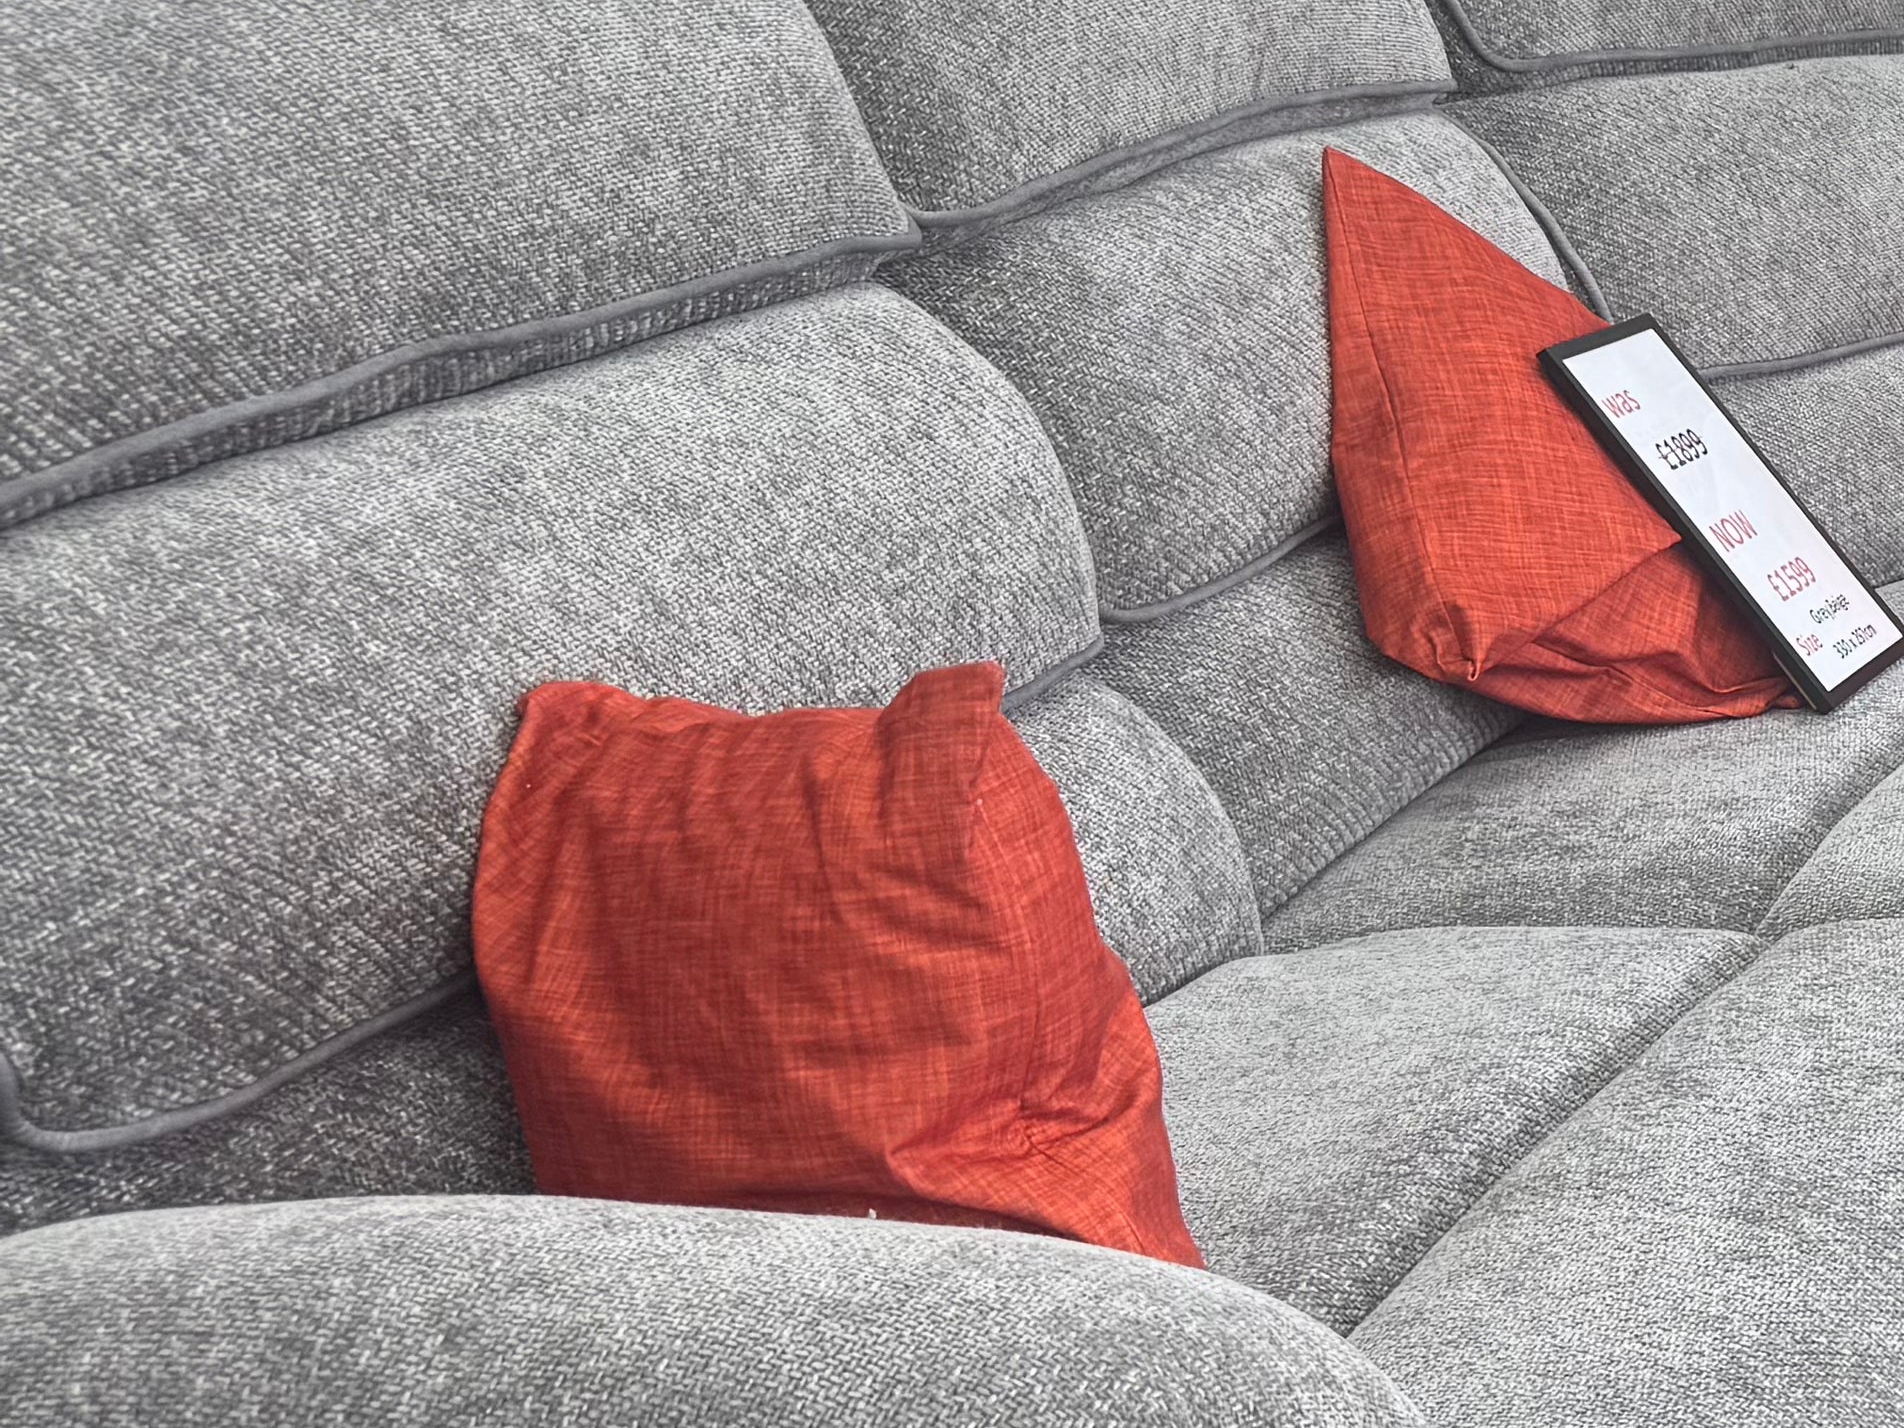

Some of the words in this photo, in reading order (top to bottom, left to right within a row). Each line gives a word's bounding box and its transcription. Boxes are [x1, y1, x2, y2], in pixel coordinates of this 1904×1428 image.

[1601, 390, 1641, 418] was
[1655, 428, 1709, 470] £1899
[1708, 509, 1757, 552] NOW
[1767, 557, 1816, 602] £1599
[1796, 632, 1823, 656] Size
